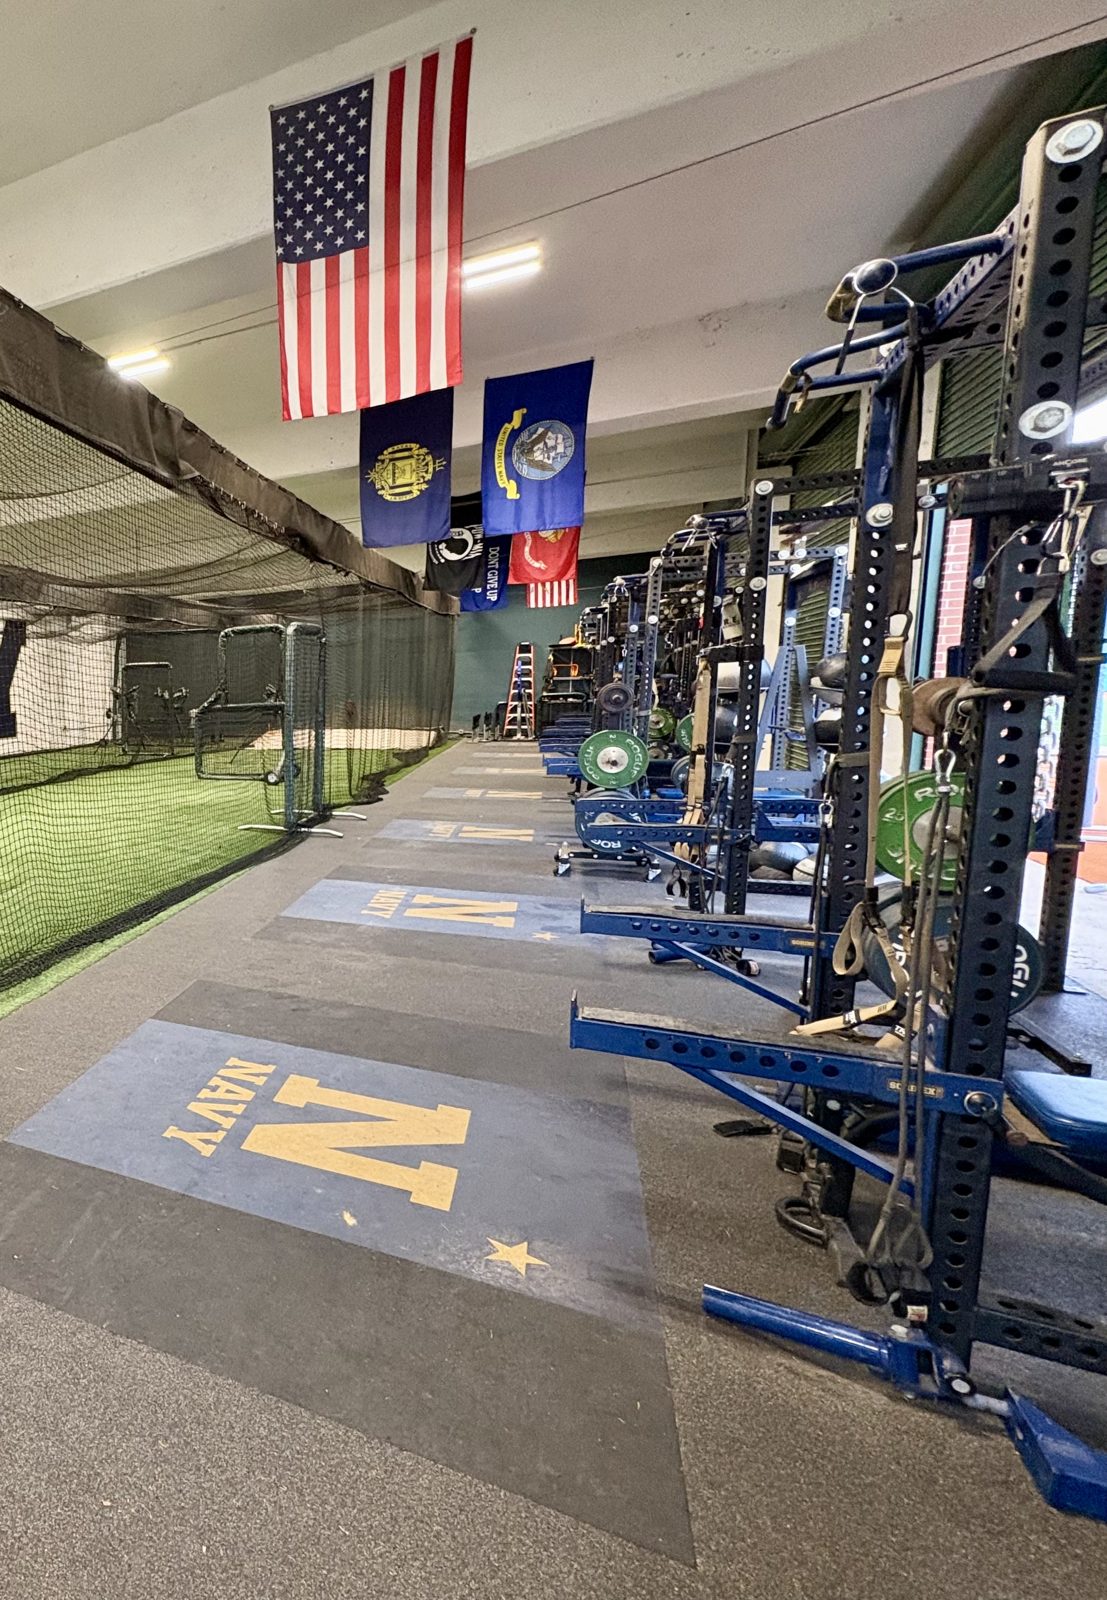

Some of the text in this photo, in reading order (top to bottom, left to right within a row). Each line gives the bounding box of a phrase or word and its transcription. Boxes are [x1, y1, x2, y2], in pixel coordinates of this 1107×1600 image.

[486, 546, 500, 602] DONT GIVE UP
[361, 890, 408, 919] NAVY
[404, 894, 519, 929] N
[162, 1056, 278, 1158] NAVY
[240, 1074, 472, 1212] N
